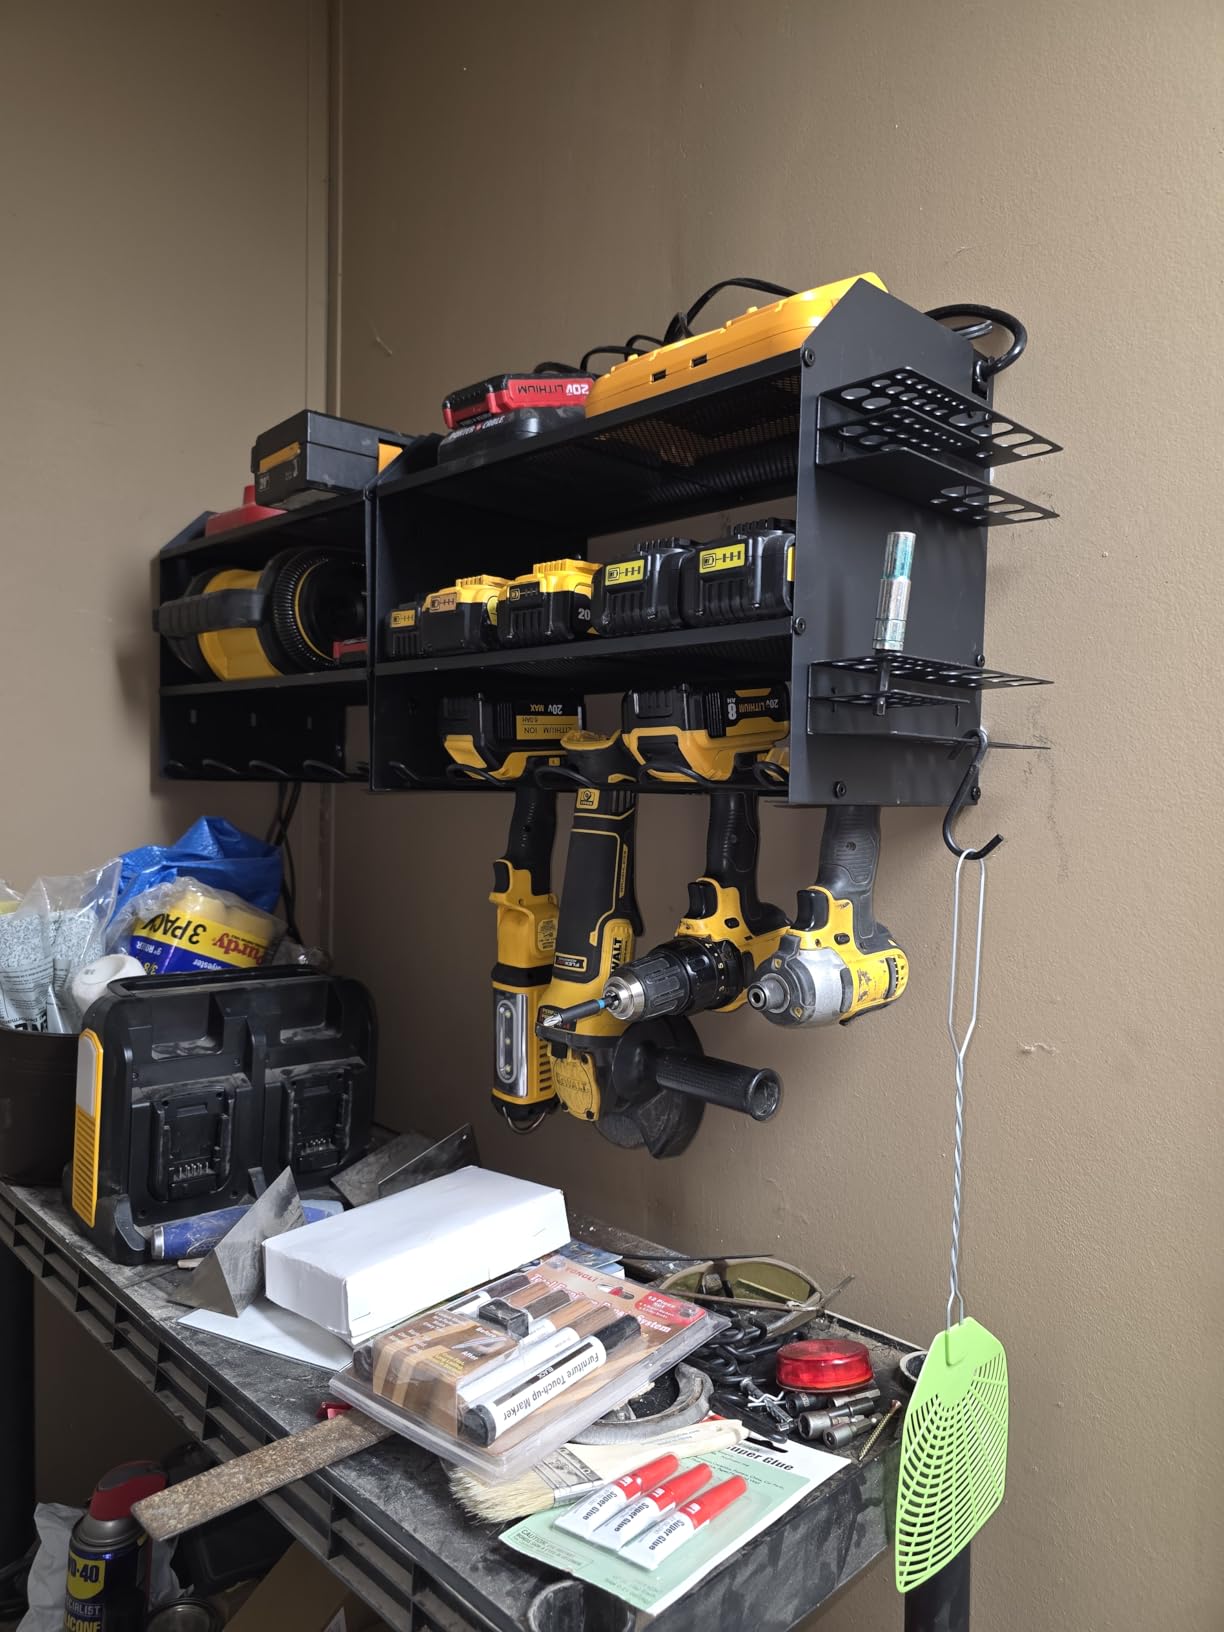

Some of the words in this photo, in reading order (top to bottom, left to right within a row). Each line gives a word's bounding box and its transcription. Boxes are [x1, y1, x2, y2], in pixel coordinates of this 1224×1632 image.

[518, 385, 563, 395] LITHIUM
[566, 384, 589, 395] 20V
[530, 704, 544, 712] MAX
[727, 703, 737, 720] 8
[739, 702, 765, 712] LITHIUM
[188, 924, 207, 945] 3
[212, 933, 264, 966] Purdy
[611, 938, 622, 972] WALT
[636, 1314, 672, 1333] System
[566, 1352, 600, 1378] Furniture
[532, 1376, 567, 1402] Touch-up
[503, 1398, 531, 1421] Marker
[726, 1445, 762, 1459] uper
[762, 1456, 794, 1471] Glue
[597, 1490, 618, 1507] Super
[583, 1506, 599, 1520] Glue
[629, 1502, 649, 1519] Super
[664, 1519, 685, 1536] Super
[649, 1535, 666, 1550] Glue
[69, 1558, 99, 1583] D-40
